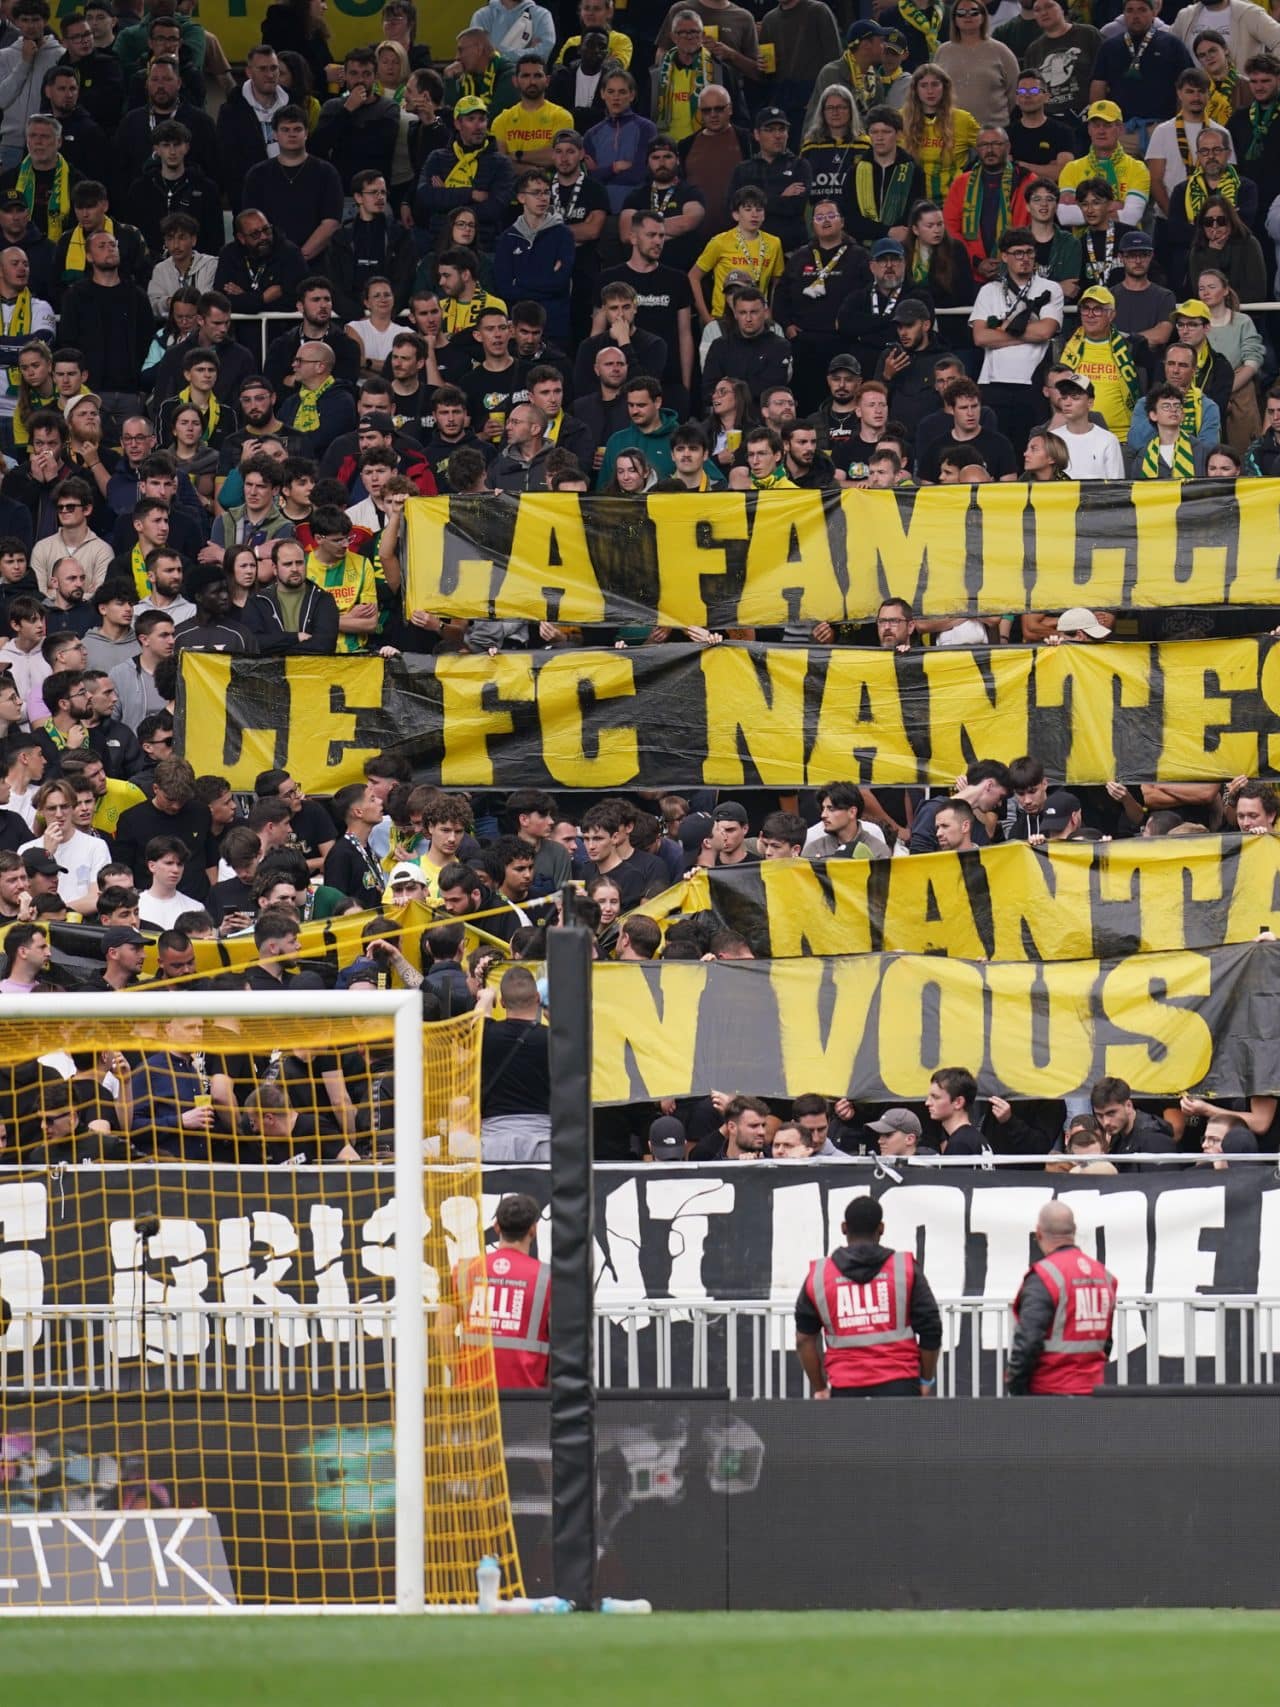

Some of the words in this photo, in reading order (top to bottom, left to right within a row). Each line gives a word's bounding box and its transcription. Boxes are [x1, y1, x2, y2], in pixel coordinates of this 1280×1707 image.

[507, 128, 553, 142] SYNERGIE
[1078, 363, 1117, 374] YNERGI
[407, 497, 606, 625] LA
[181, 651, 384, 793] LE
[440, 652, 640, 788] FC
[770, 950, 1213, 1100] VOUS
[470, 1285, 512, 1319] ALL
[837, 1282, 880, 1317] ALL
[1075, 1287, 1102, 1320] ALL
